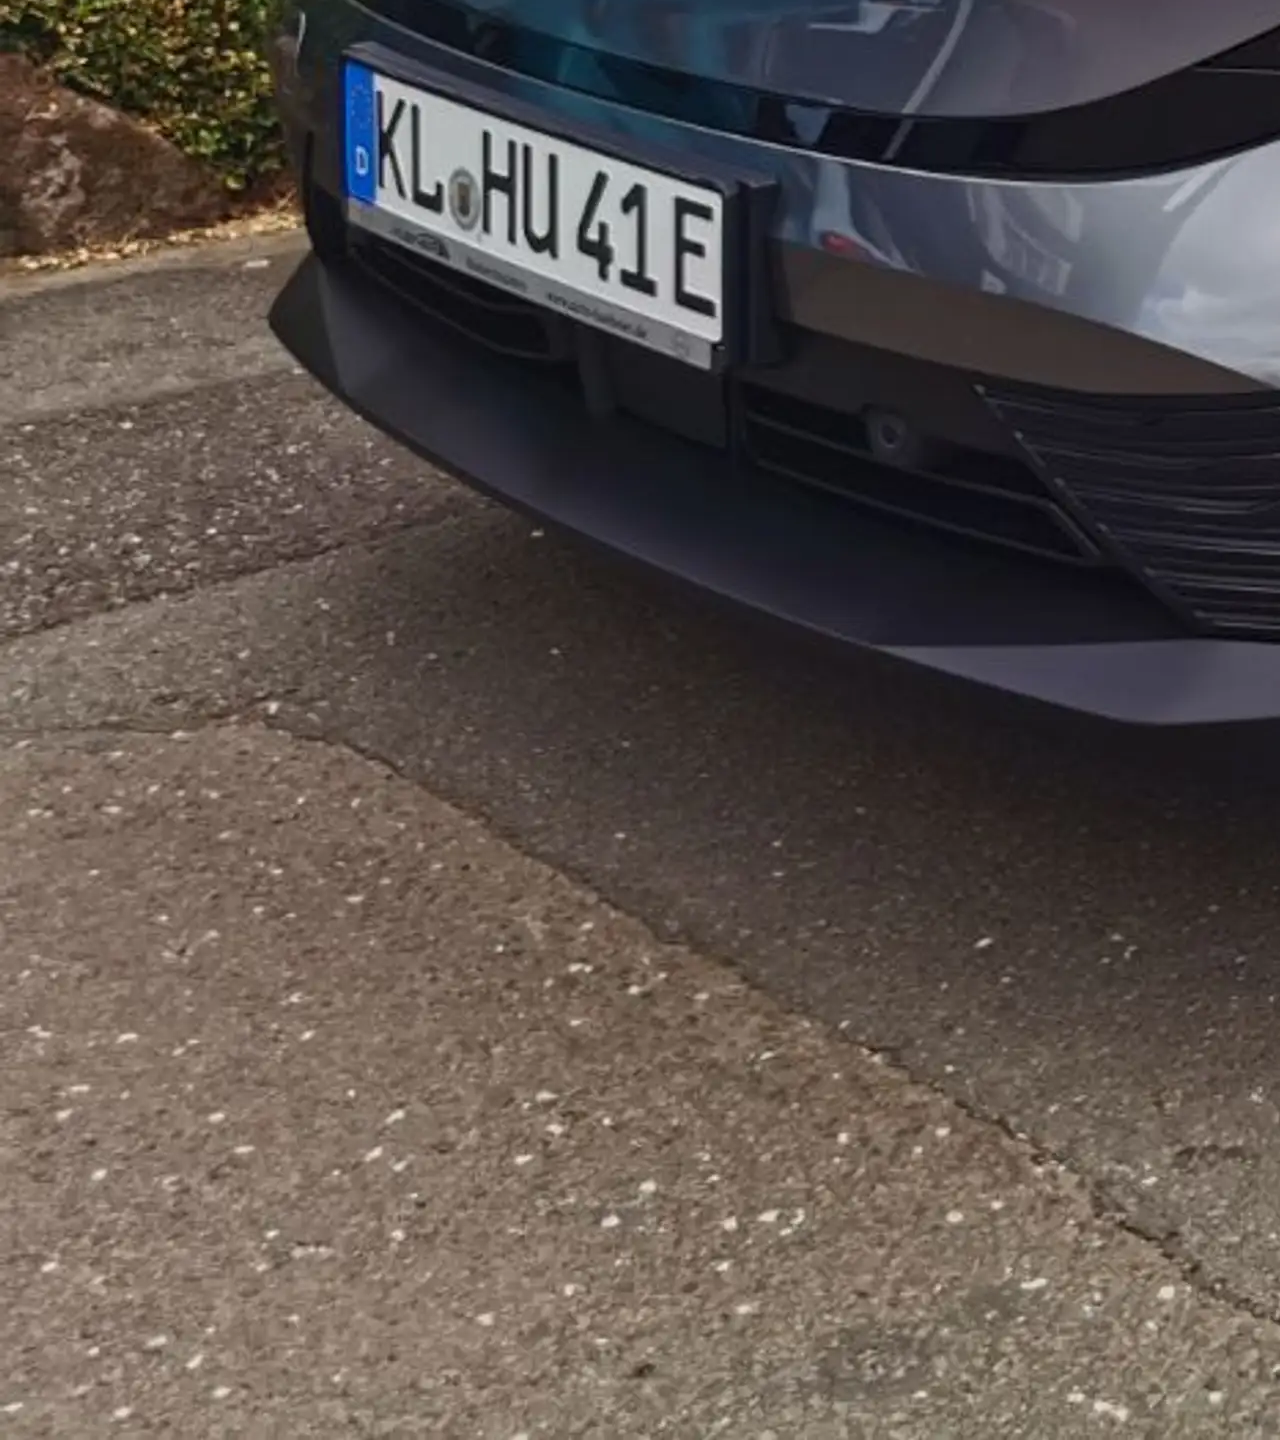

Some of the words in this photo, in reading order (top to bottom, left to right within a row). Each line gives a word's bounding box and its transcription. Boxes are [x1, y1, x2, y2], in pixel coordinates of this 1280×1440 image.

[355, 145, 370, 176] D
[375, 90, 443, 215] KL
[482, 130, 559, 260] HU
[577, 171, 717, 319] 41E
